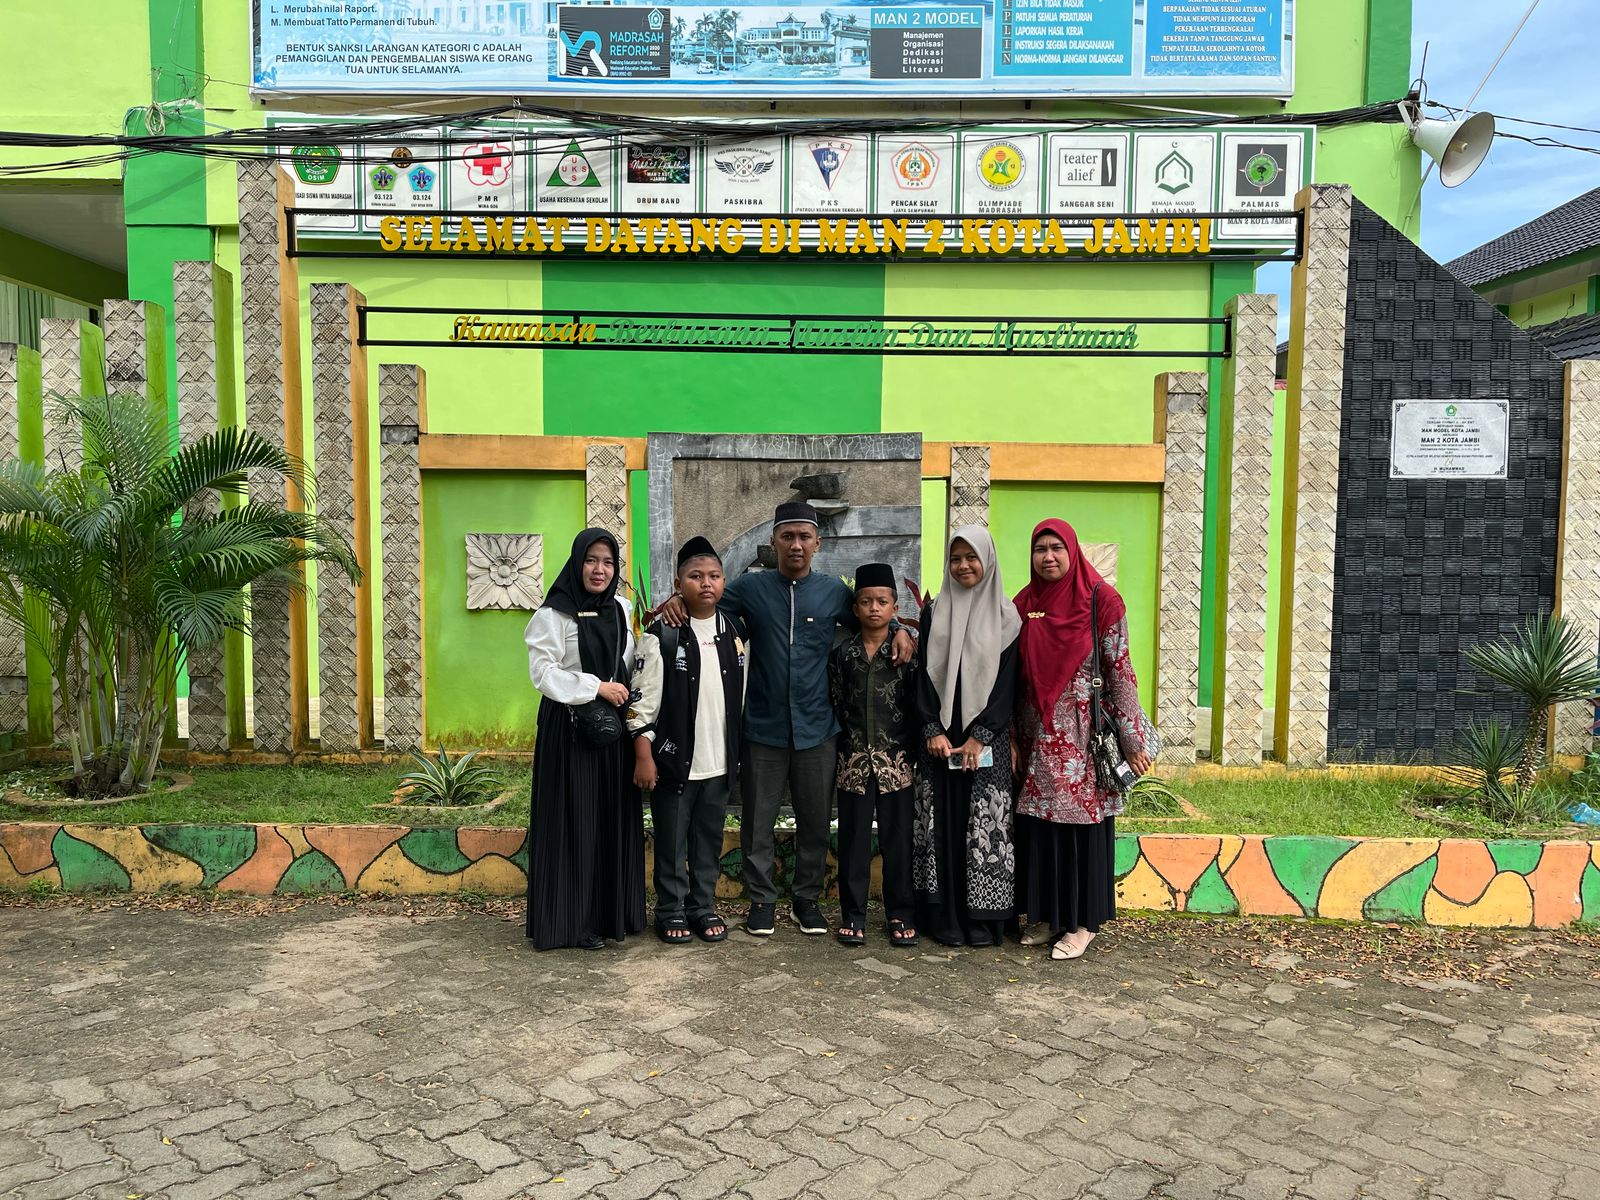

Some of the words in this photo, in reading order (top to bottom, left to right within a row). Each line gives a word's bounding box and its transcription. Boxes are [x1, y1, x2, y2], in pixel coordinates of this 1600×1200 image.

[271, 5, 279, 13] L.
[284, 5, 322, 13] Merubah
[345, 5, 377, 14] Raport.
[874, 12, 908, 24] MAN
[912, 12, 920, 24] 2
[925, 12, 979, 24] MODEL
[1016, 12, 1036, 21] PATUHI
[1038, 12, 1058, 21] SEMUA
[1060, 12, 1093, 21] PERATURAN
[271, 18, 281, 26] M.
[284, 18, 324, 26] Membuat
[326, 18, 348, 26] Tatto
[350, 18, 394, 26] Permanen
[396, 18, 405, 26] di
[407, 18, 437, 26] Tubuh.
[1015, 26, 1046, 35] LAPORKAN
[1048, 26, 1064, 35] HASIL
[1066, 26, 1084, 35] KERJA
[610, 32, 664, 43] MADRASAH
[903, 32, 944, 40] Manajemen
[286, 44, 325, 52] BENTUK
[327, 44, 363, 52] SANKSI
[366, 44, 418, 52] LARANGAN
[422, 44, 470, 52] KATEGORI
[473, 44, 480, 52] C
[482, 44, 522, 52] ADALAH
[1015, 40, 1044, 49] INSTRUKSI
[1046, 40, 1068, 49] SEGERA
[1069, 40, 1114, 49] DILAKSANAKAN
[610, 45, 649, 56] REFORM
[276, 54, 346, 62] PEMANGGILAN
[348, 54, 368, 62] DAN
[371, 54, 447, 62] PENGEMBALIAN
[450, 54, 480, 62] SISWA
[482, 54, 495, 62] KE
[498, 54, 533, 62] ORANG
[1014, 54, 1061, 64] NORMA-NORMA
[1062, 54, 1087, 64] JANGAN
[1089, 54, 1124, 64] DILANGGAR
[345, 66, 364, 74] TUA
[366, 66, 400, 74] UNTUK
[402, 66, 462, 74] SELAMANYA.
[1064, 153, 1098, 164] teater
[1067, 168, 1095, 181] alief
[380, 216, 570, 252] SELAMAT
[585, 217, 746, 254] DATANG
[760, 218, 802, 254] DI
[816, 218, 910, 254] MAN
[923, 218, 946, 254] 2
[961, 218, 1069, 254] KOTA
[1084, 218, 1212, 254] JAMBI
[448, 315, 598, 342] Kawasan
[604, 319, 770, 346] Berbusana
[906, 321, 974, 348] Dan
[979, 319, 1140, 350] Muslimah
